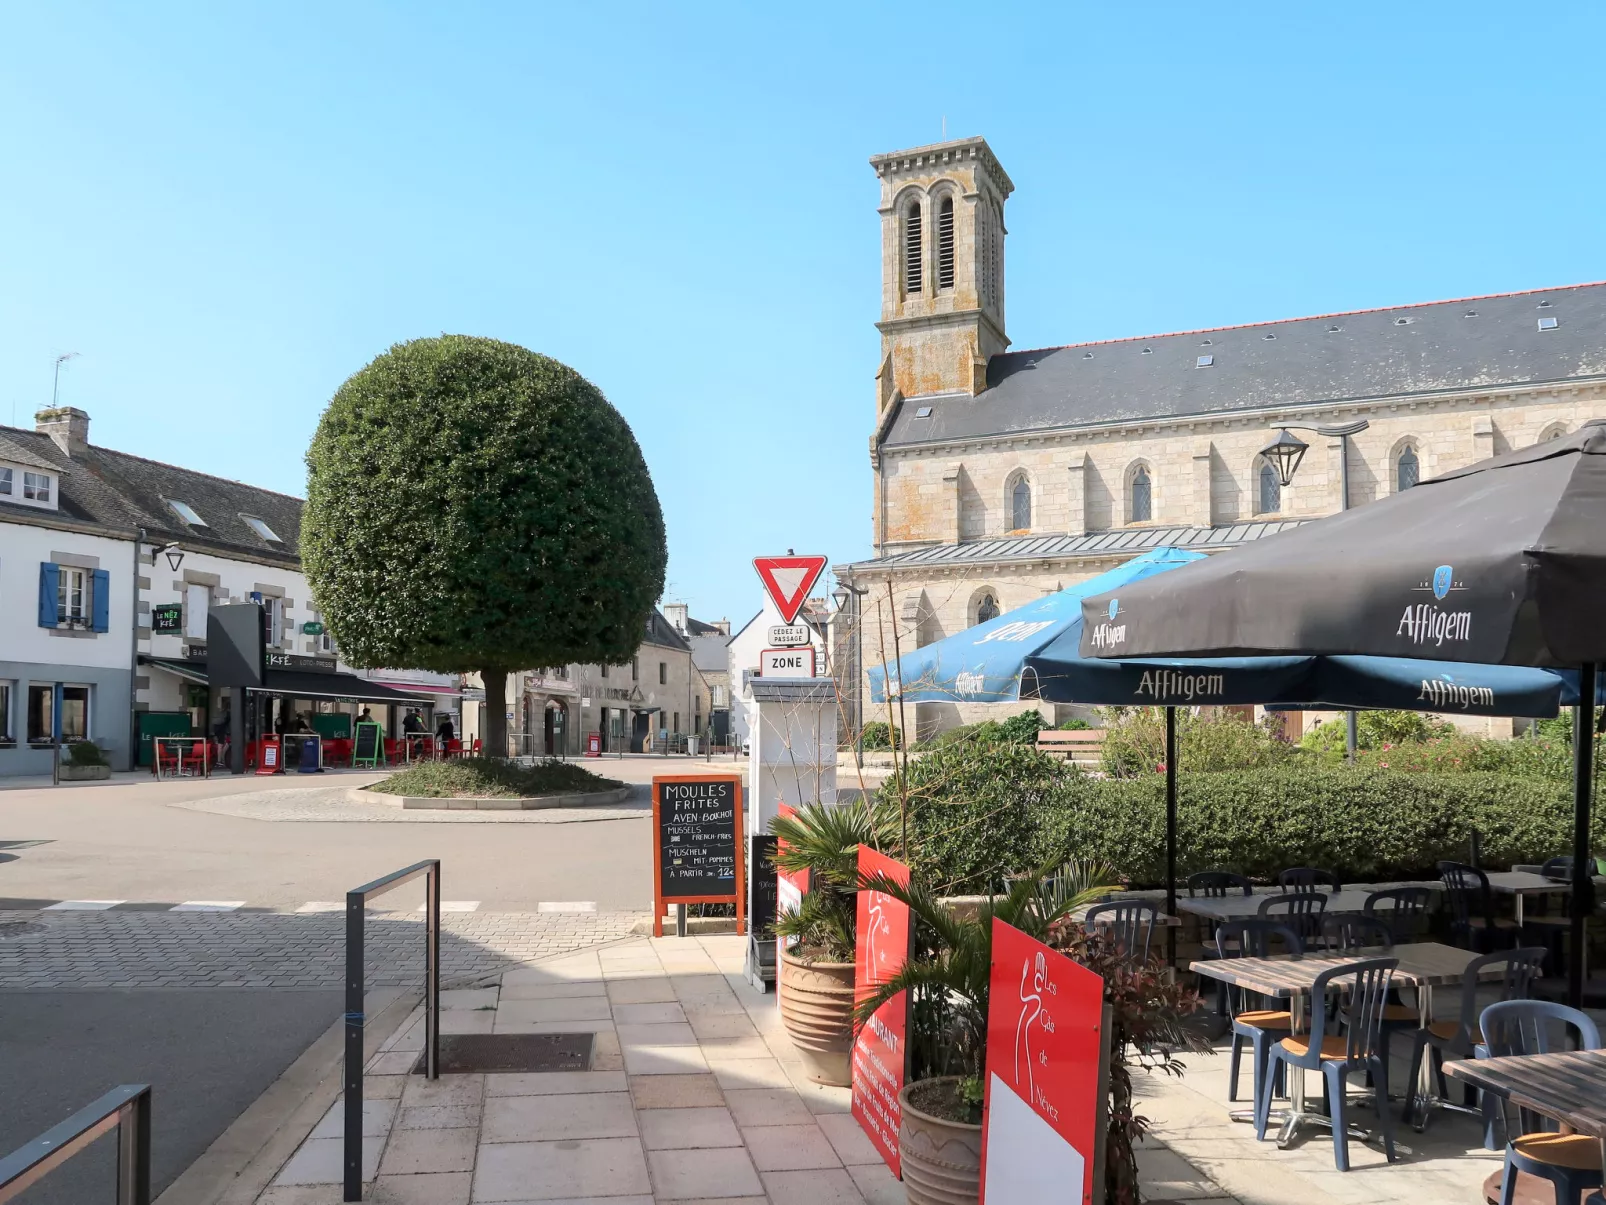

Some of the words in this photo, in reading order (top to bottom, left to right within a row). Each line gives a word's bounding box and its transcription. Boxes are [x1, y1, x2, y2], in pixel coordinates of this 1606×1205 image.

[1396, 604, 1471, 647] Affligem
[1091, 624, 1126, 648] Affligem
[772, 658, 802, 668] ZONE
[1134, 670, 1224, 700] Affligem
[1417, 680, 1494, 709] Affligem
[666, 784, 726, 800] MOULES
[668, 826, 702, 834] MUSSELS
[668, 848, 708, 858] MUSCHELN
[1044, 966, 1057, 996] Les
[1039, 1050, 1048, 1066] de
